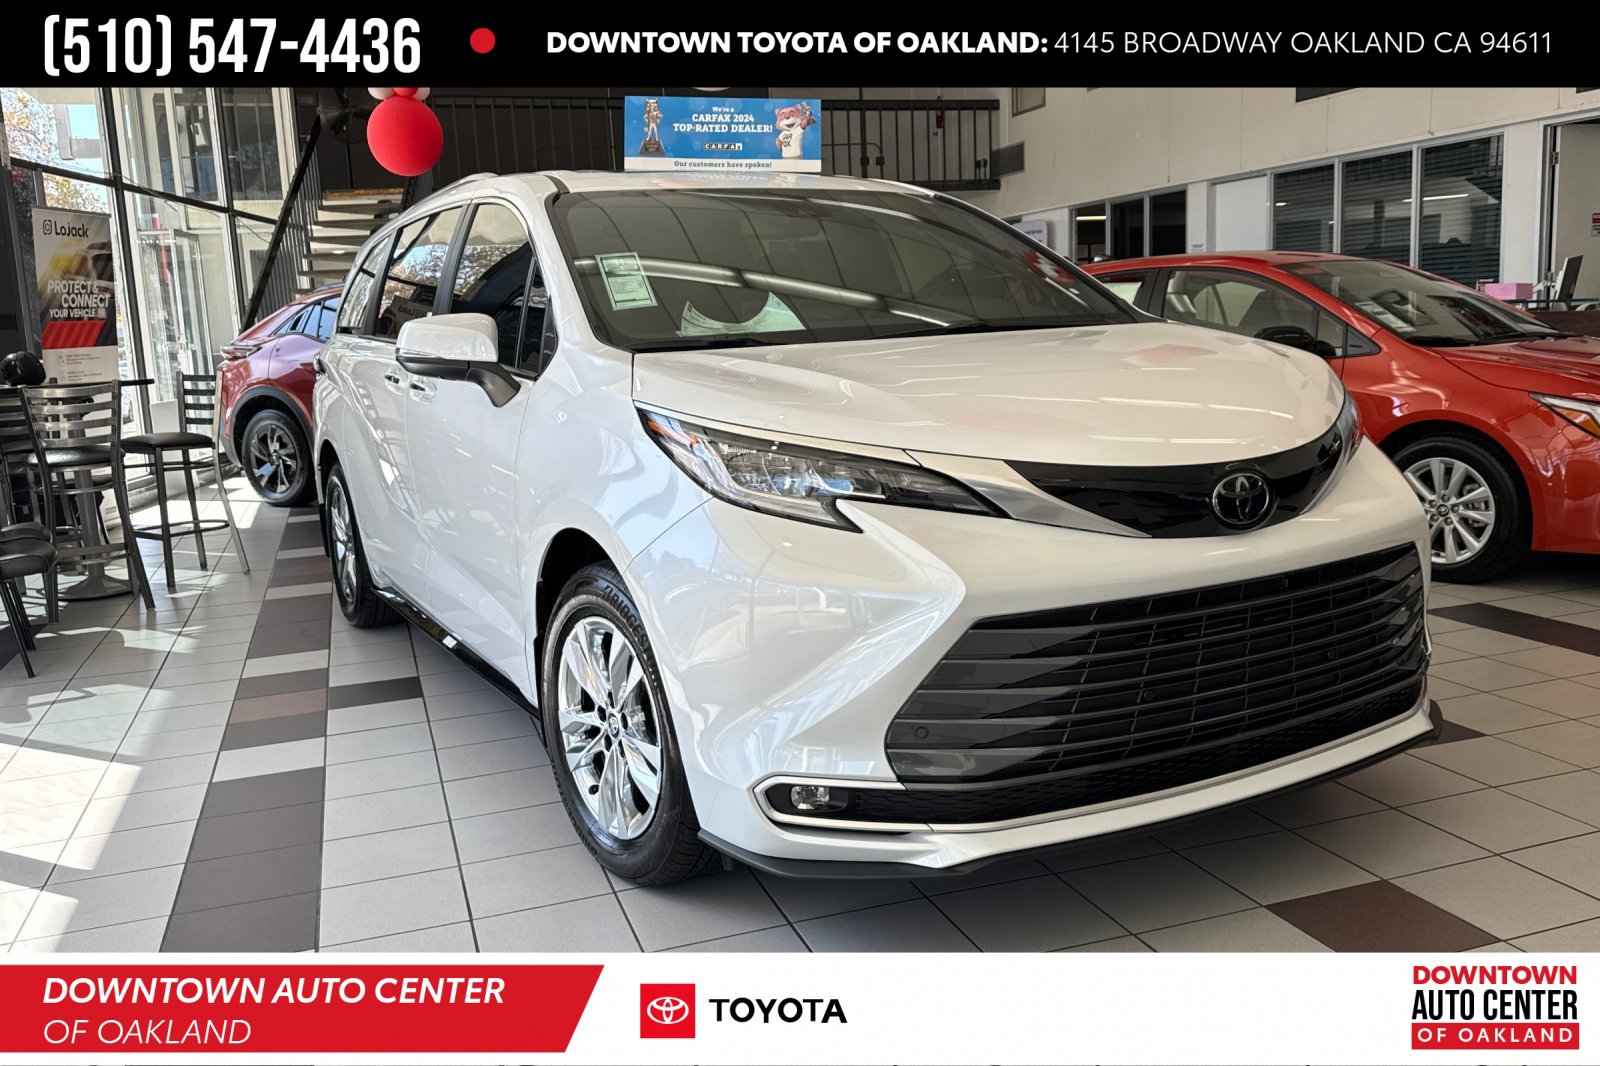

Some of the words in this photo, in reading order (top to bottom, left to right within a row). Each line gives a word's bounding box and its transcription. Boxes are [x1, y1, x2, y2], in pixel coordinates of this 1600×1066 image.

[692, 113, 732, 123] CARFAX
[733, 114, 755, 123] 2024
[672, 123, 729, 133] TOP-RATED
[730, 124, 773, 133] DEALER!
[674, 160, 688, 168] Our
[727, 161, 744, 169] have
[745, 161, 773, 170] spoken!
[54, 220, 89, 238] Lojack
[61, 293, 111, 308] CONNECT
[49, 308, 69, 318] YOUR
[69, 308, 97, 318] VEHICLE
